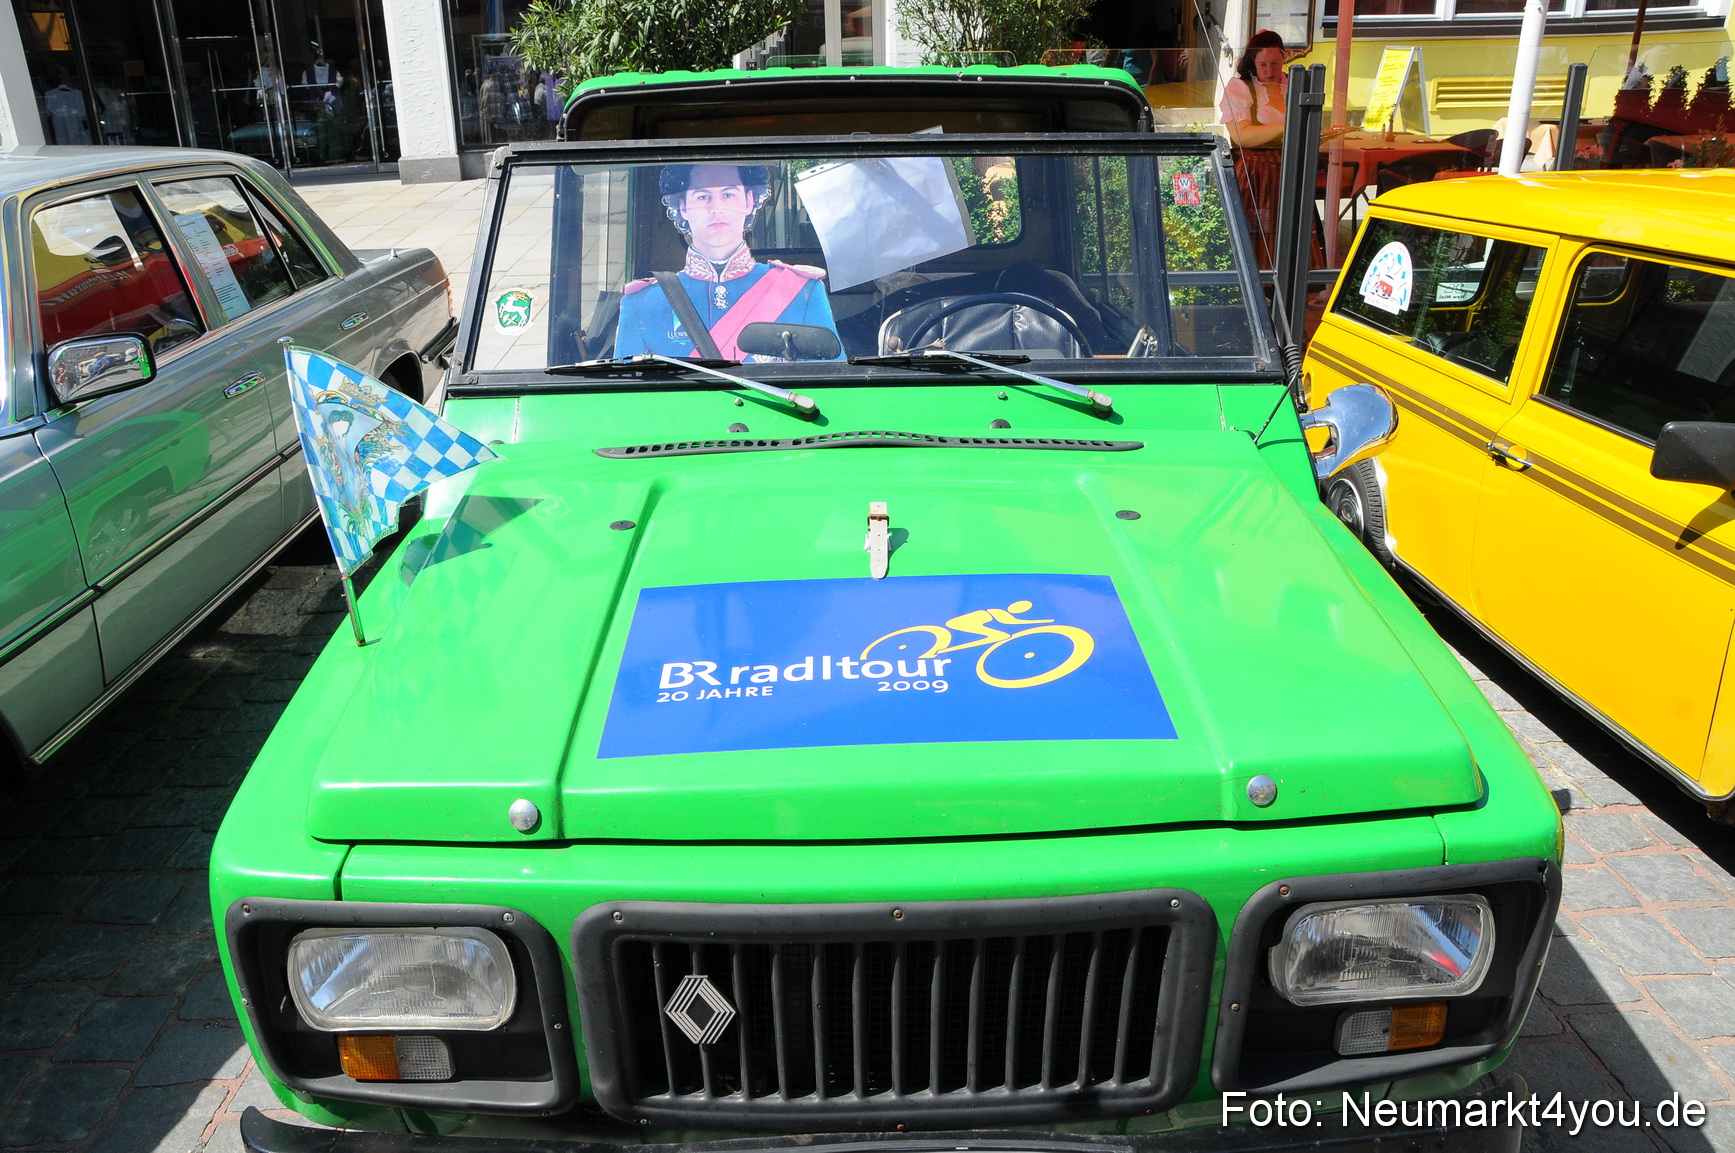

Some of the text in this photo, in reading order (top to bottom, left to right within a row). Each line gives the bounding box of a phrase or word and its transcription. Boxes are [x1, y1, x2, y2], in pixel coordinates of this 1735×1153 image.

[659, 655, 952, 689] BR radltour
[656, 686, 773, 702] 20 JAHRE
[877, 680, 949, 693] 2009
